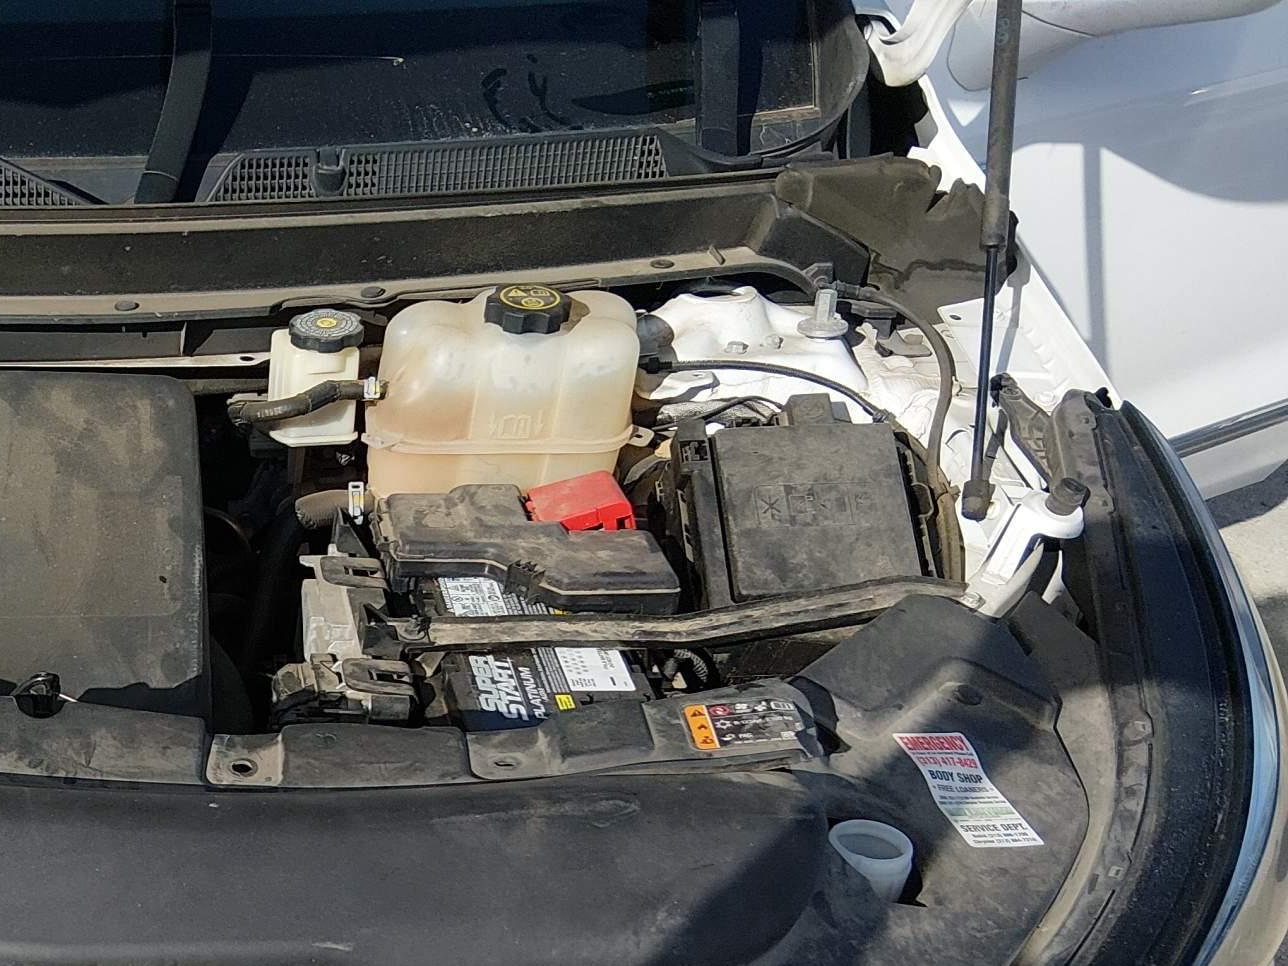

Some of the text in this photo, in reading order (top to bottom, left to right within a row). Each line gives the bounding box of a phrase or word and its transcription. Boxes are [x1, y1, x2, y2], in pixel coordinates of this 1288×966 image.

[468, 655, 506, 711] SUPER
[487, 655, 529, 721] START
[517, 667, 548, 719] PLATINUM
[899, 735, 970, 751] EMERGENCY
[928, 769, 983, 784] BODY SHOP
[961, 823, 1028, 833] SERVICE DEPT.
